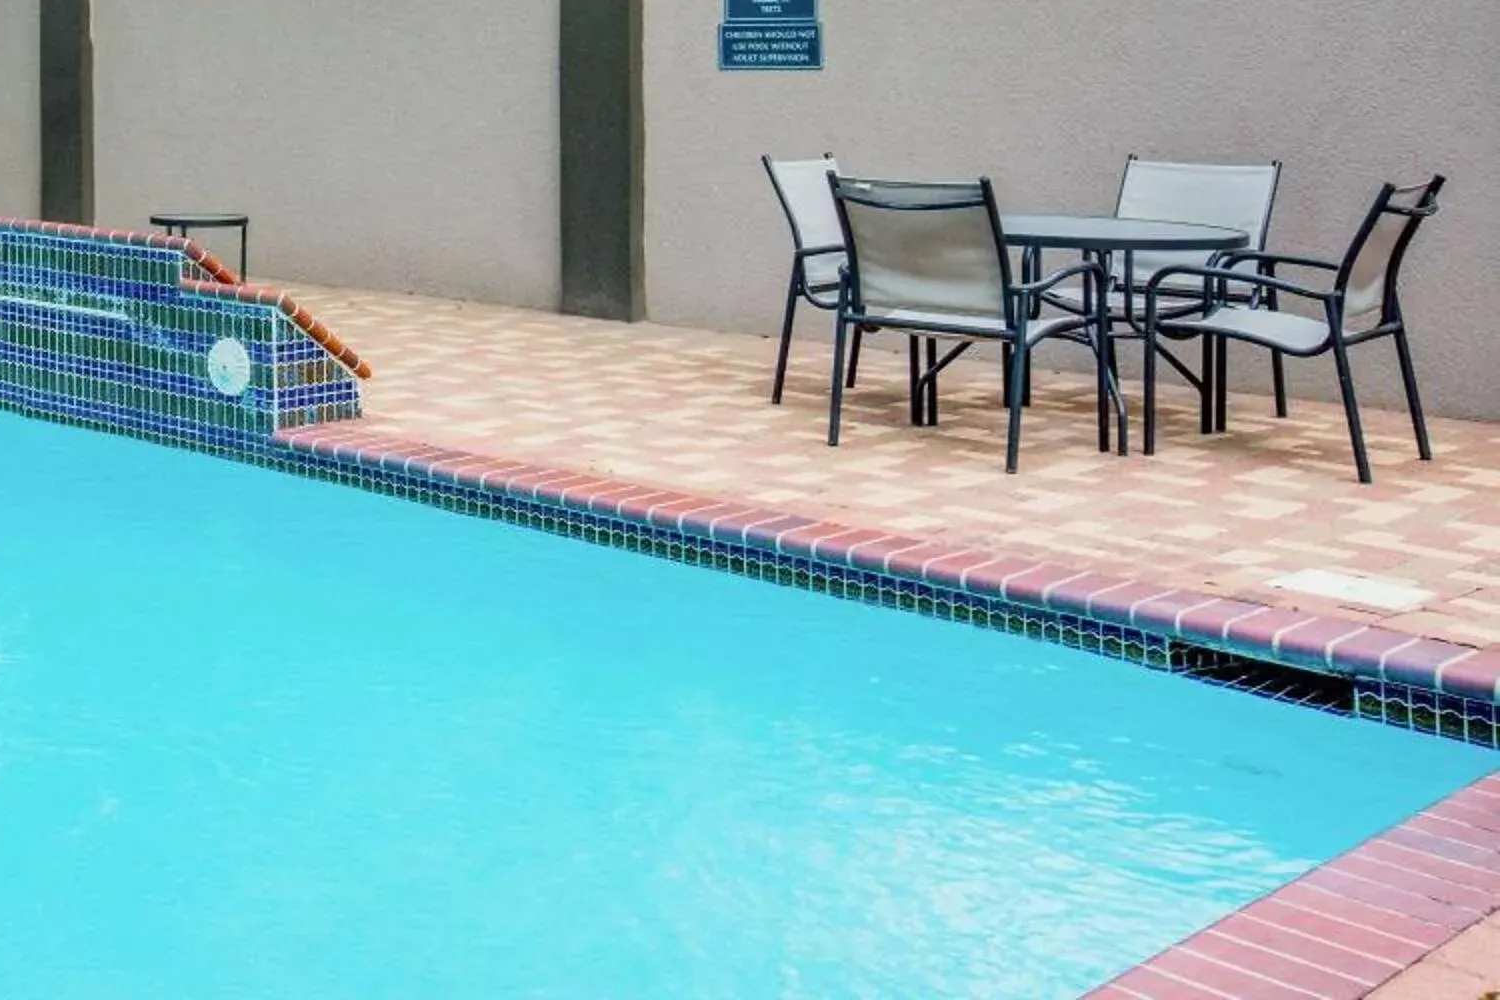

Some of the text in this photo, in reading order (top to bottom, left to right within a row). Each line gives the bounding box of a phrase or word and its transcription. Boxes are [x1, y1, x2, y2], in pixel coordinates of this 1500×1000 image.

[725, 31, 762, 39] CHILDREN
[798, 29, 815, 38] NOT
[748, 42, 769, 50] POOL
[771, 41, 809, 50] WITHOUT
[733, 53, 809, 62] ADULT SUPERVISION
